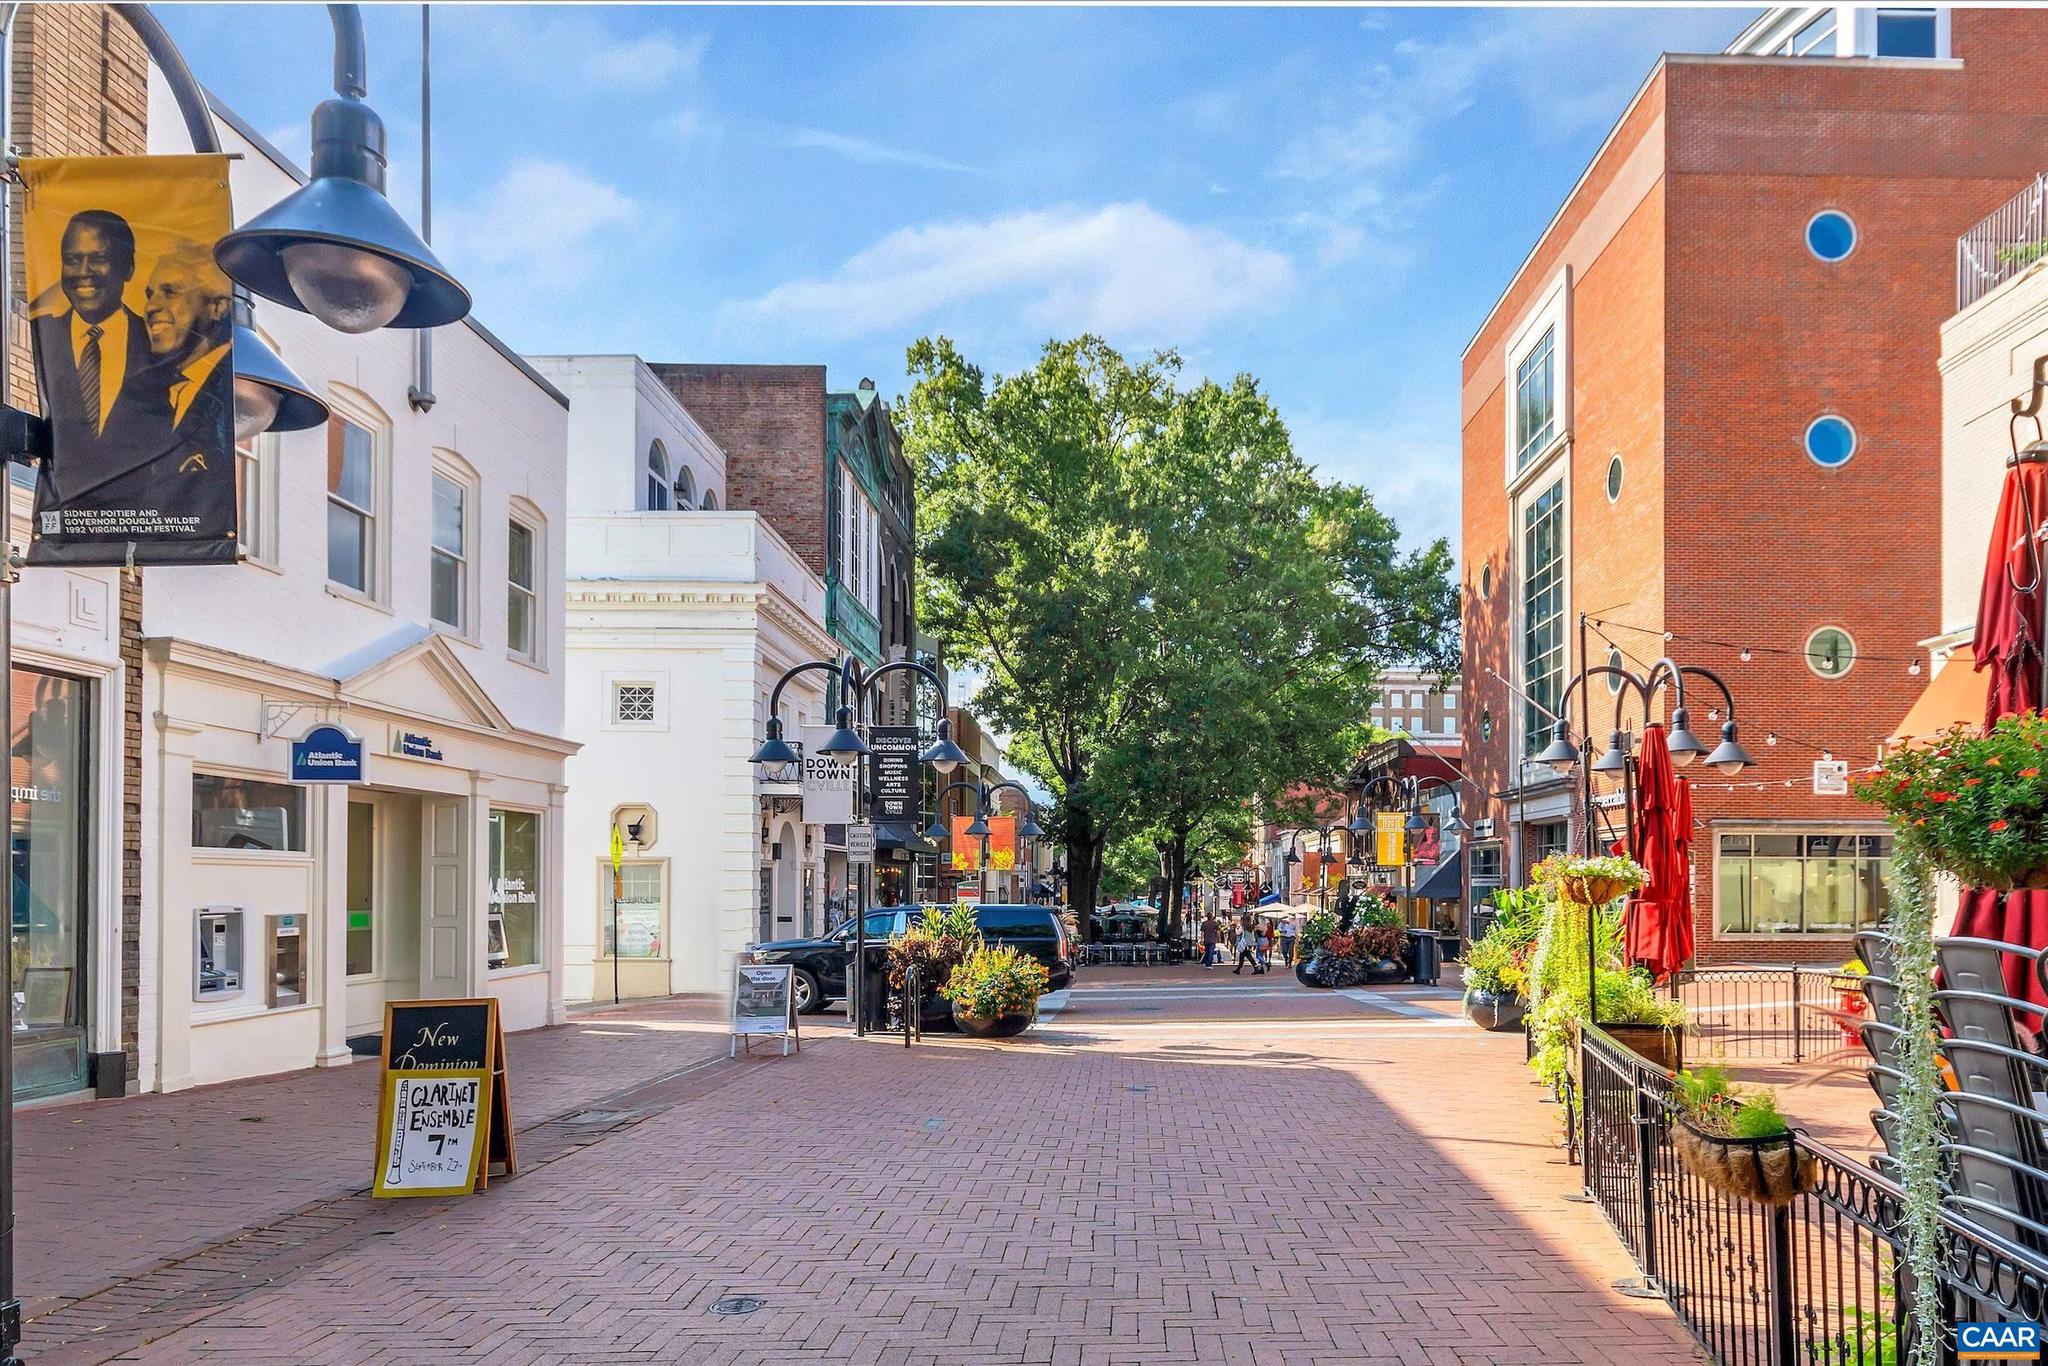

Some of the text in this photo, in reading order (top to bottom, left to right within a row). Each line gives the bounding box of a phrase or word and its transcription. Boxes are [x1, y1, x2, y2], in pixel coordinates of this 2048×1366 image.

[64, 510, 98, 518] SIDNEY
[64, 517, 200, 526] GOVERNOR DOUGLAS WILDER
[66, 526, 86, 534] 1992
[131, 525, 153, 533] FILM
[154, 525, 196, 533] FESTIVAL
[308, 759, 358, 767] Union Bank
[806, 769, 851, 779] TOWN
[806, 781, 851, 791] CVILLE
[518, 890, 537, 903] Bank
[413, 1022, 459, 1047] New
[395, 1048, 479, 1070] Dominion
[411, 1082, 478, 1107] CLARINET
[410, 1109, 475, 1132] ENSEMBLE
[428, 1134, 446, 1156] 7
